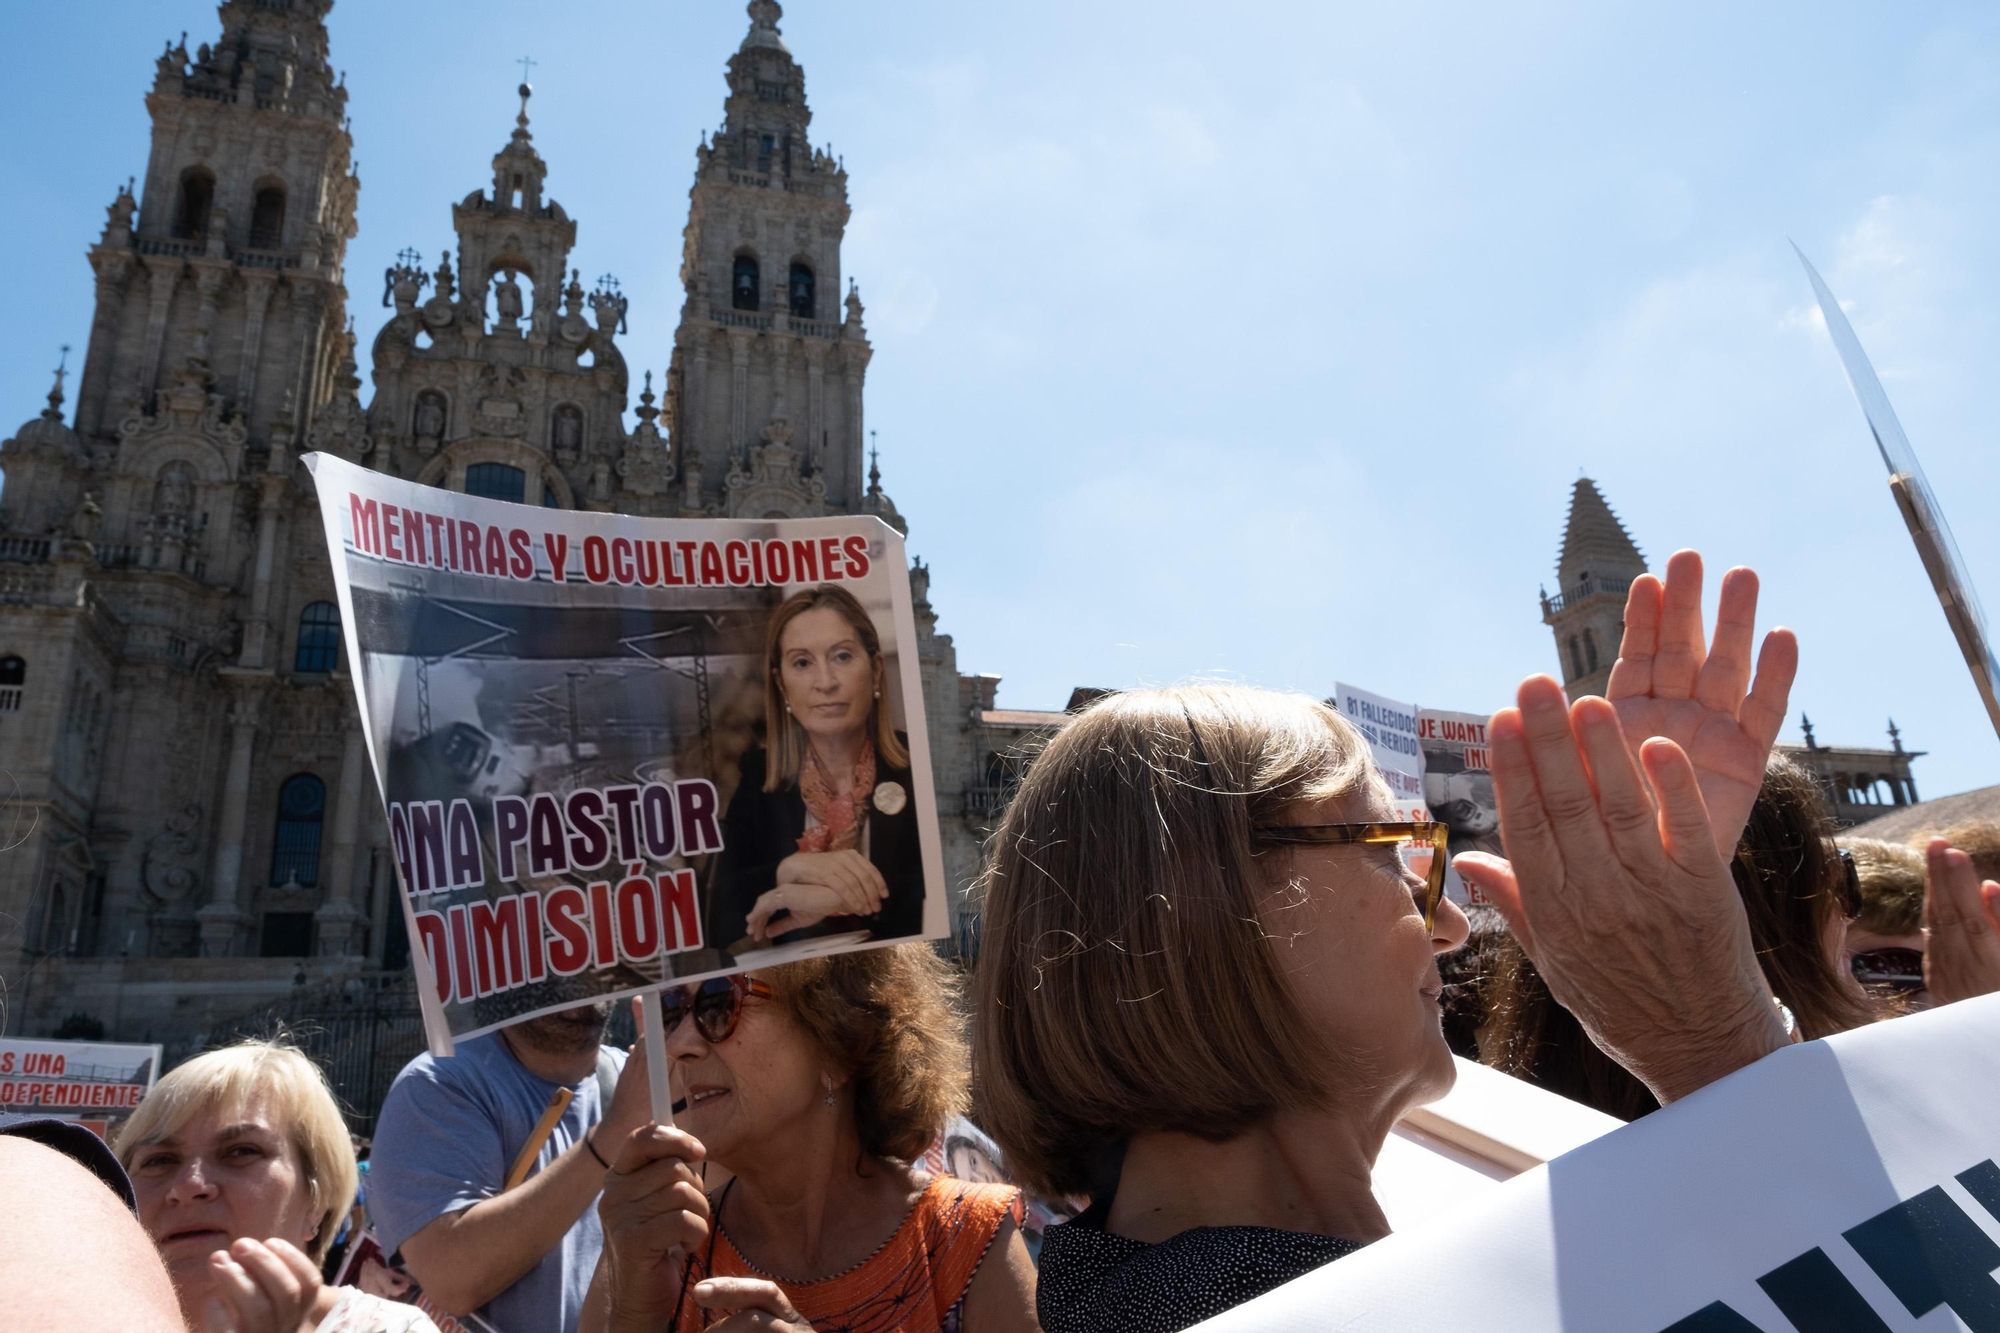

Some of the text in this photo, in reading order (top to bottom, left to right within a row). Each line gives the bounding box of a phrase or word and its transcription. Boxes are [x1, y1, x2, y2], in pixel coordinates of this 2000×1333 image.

[348, 492, 870, 586] MENTIRAS Y OCULTACIONES
[1441, 720, 1485, 744] WANT
[390, 781, 721, 893] ANA PASTOR
[415, 862, 702, 1004] DIMISIÓN
[1, 1081, 141, 1106] DEPENDIENTE
[23, 1053, 66, 1075] UNA
